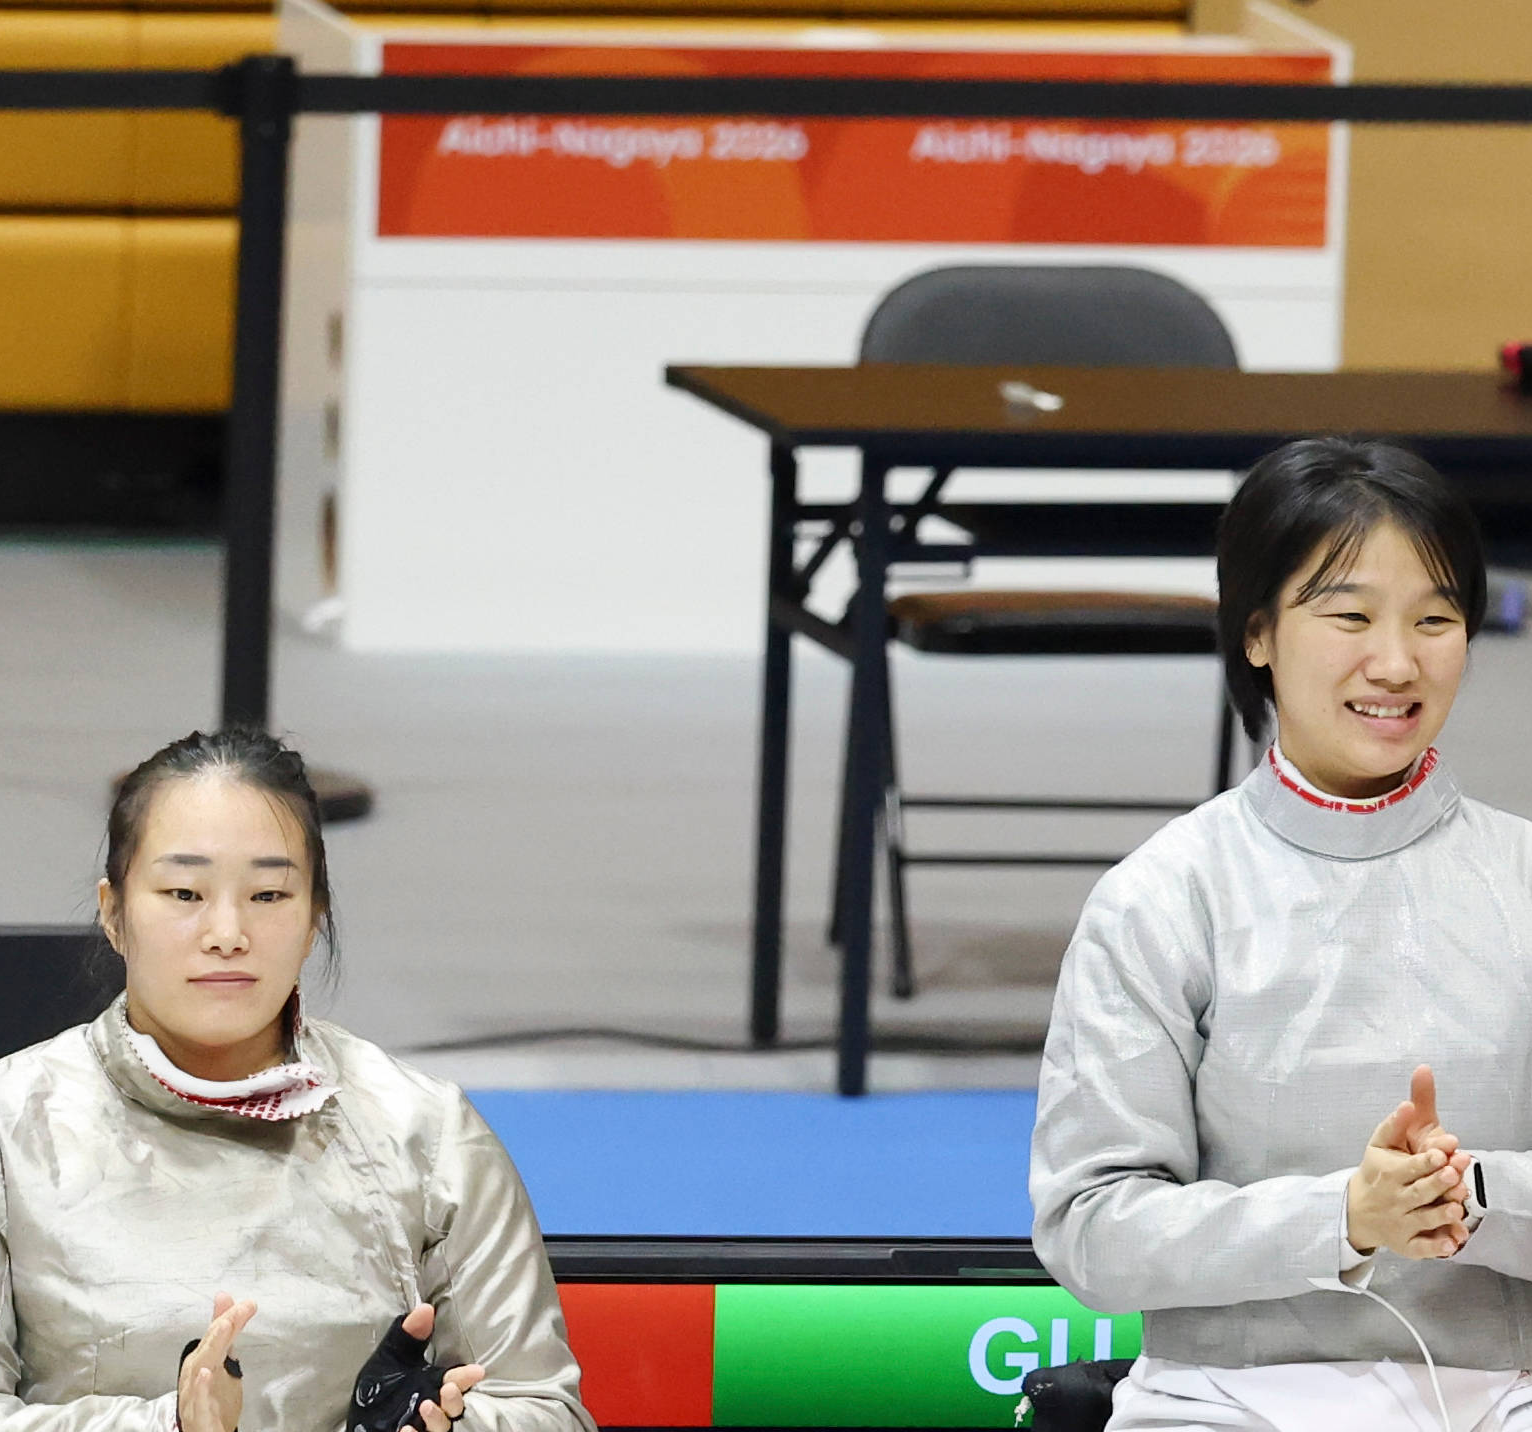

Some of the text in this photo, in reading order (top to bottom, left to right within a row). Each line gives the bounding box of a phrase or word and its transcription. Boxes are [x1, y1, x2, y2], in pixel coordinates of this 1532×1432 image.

[437, 117, 809, 167] Aichi-Nagoya 2026
[1180, 128, 1281, 167] 2026
